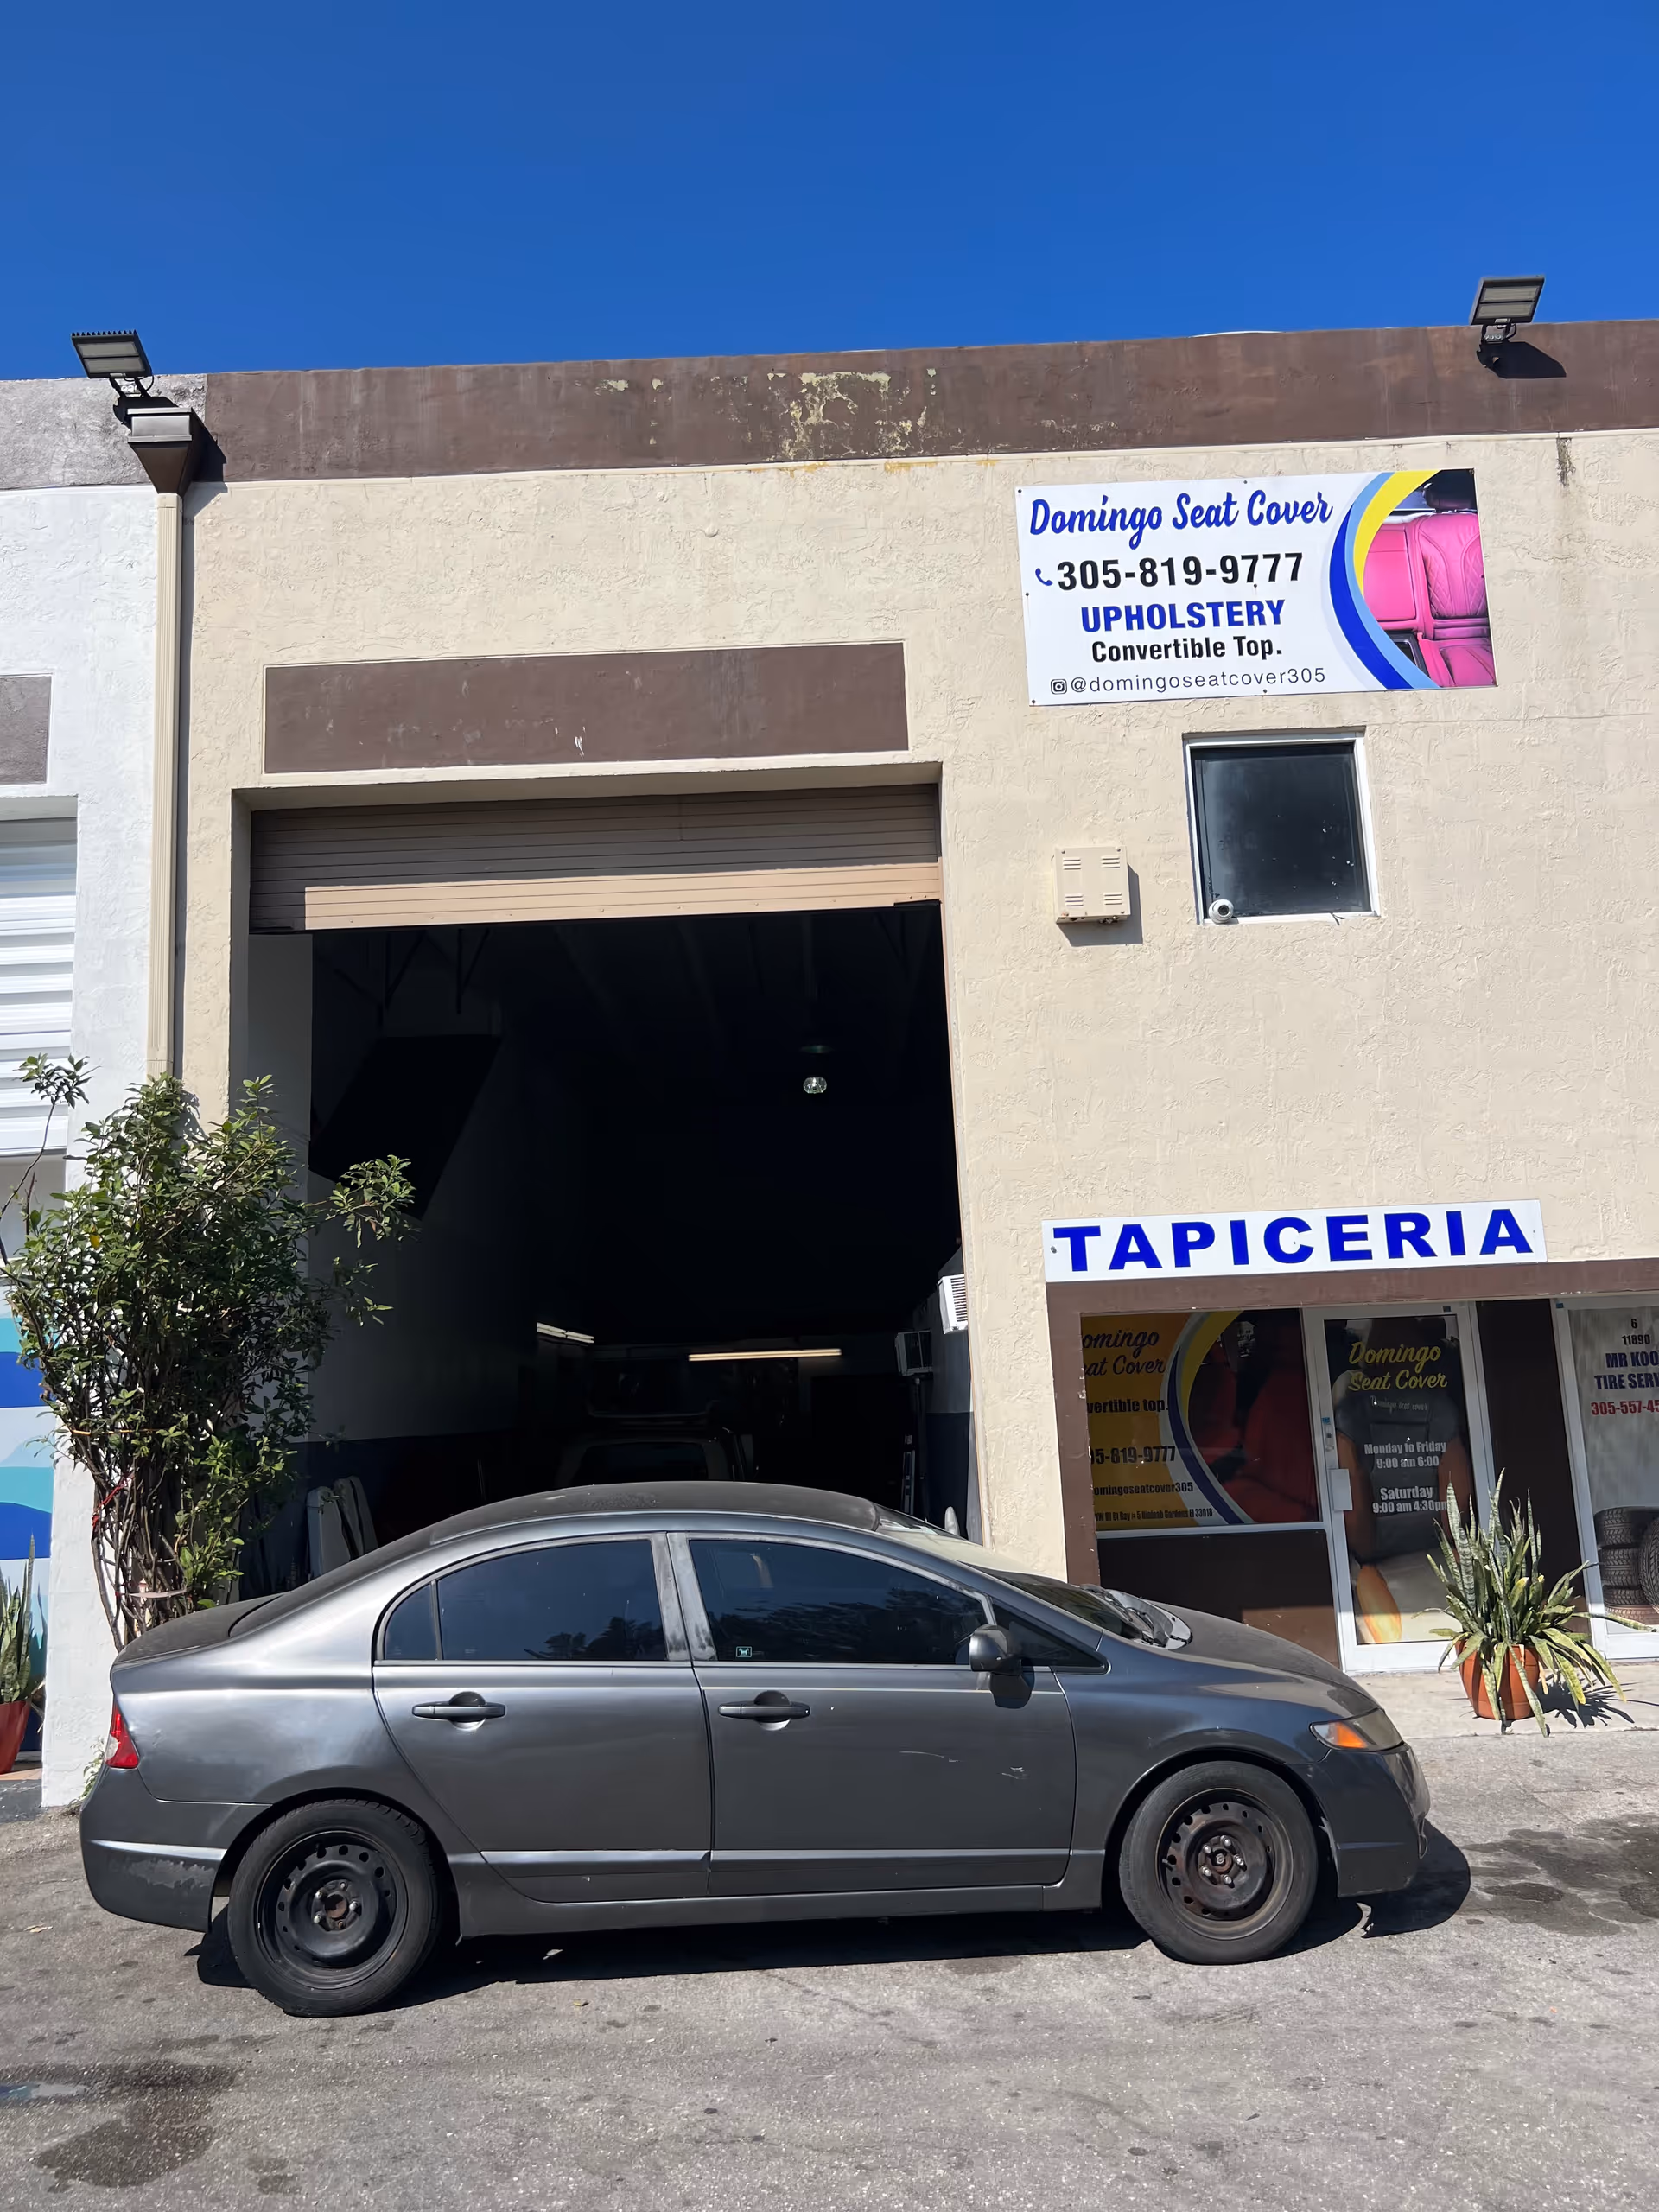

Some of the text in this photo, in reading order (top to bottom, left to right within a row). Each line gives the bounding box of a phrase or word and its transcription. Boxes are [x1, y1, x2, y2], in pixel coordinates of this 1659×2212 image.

[1029, 489, 1334, 550] Domingo Seat Cover
[1057, 552, 1304, 591] 305-819-9777
[1080, 599, 1286, 633] UPHOLSTERY
[1091, 635, 1282, 663] Convertible Top.
[1070, 667, 1326, 695] @domingoseatcover305
[1052, 1208, 1534, 1272] TAPICERIA
[1630, 1318, 1638, 1329] 6
[1622, 1334, 1650, 1345] 11890
[1112, 1355, 1166, 1375] Cover
[1348, 1341, 1441, 1374] Domingo
[1605, 1352, 1628, 1368] MR
[1348, 1369, 1448, 1392] Seat Cover
[1594, 1374, 1625, 1389] TIRE
[1363, 1441, 1446, 1455] Monday to Friday
[1376, 1455, 1440, 1469] 9:00 am 6:00
[1380, 1486, 1433, 1501] Saturday
[1372, 1502, 1395, 1514] 9:00
[1396, 1503, 1413, 1512] am
